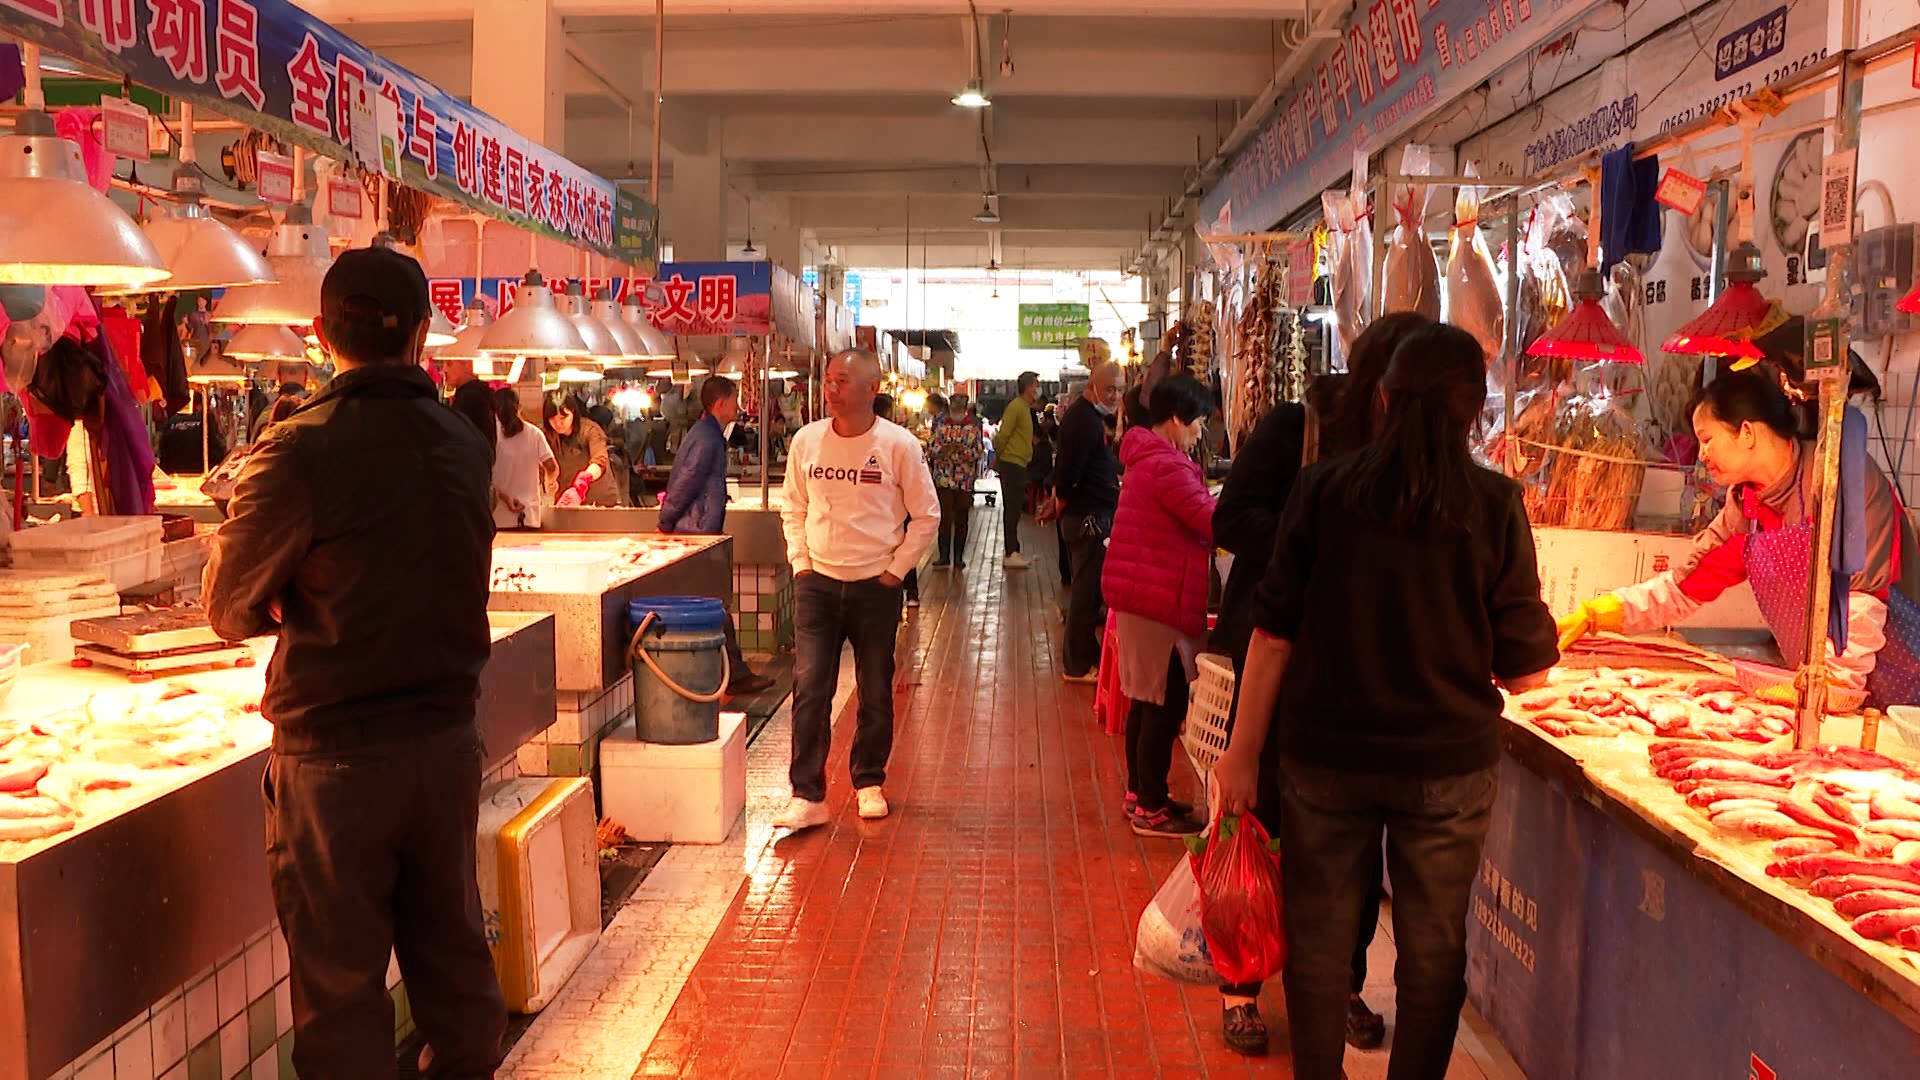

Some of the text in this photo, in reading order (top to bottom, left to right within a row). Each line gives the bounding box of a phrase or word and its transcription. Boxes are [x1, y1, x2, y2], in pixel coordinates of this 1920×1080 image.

[452, 120, 614, 248] 创建国家森林城市
[808, 463, 858, 486] lecoq
